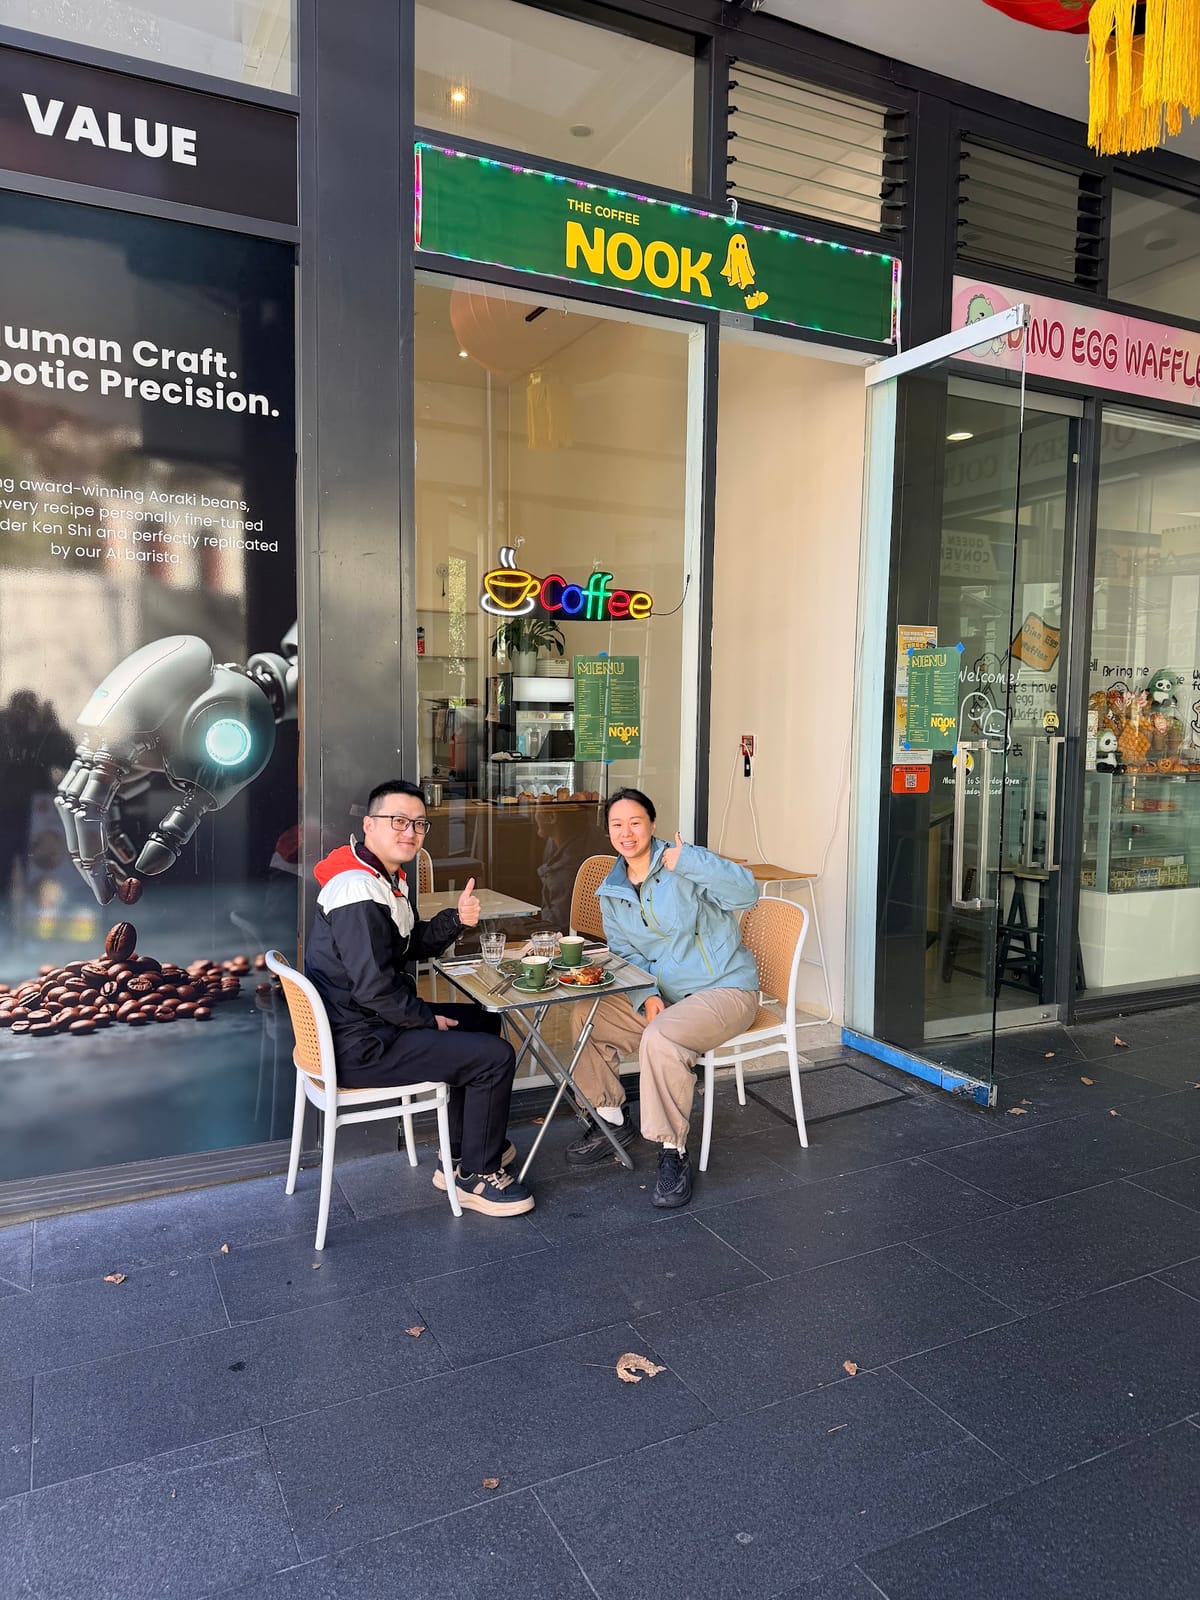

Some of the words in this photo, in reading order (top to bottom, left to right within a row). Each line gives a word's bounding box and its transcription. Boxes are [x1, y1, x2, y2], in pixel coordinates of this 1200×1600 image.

[22, 93, 197, 166] VALUE
[567, 198, 591, 215] THE
[594, 203, 640, 226] COFFEE
[566, 221, 712, 297] NOOK
[132, 340, 238, 380] Craft.
[1072, 326, 1118, 370] EGG
[100, 368, 280, 417] Precision.
[20, 480, 144, 504] award-winning
[149, 489, 197, 506] Aoraki
[201, 495, 250, 513] beans,
[44, 502, 94, 519] recipe
[100, 507, 180, 526] personally
[184, 512, 263, 532] fine-tuned
[33, 520, 63, 535] Ken
[68, 522, 92, 537] Shi
[97, 526, 127, 540] and
[132, 528, 200, 548] perfectly
[204, 534, 279, 553] replicated
[51, 543, 69, 558] by
[75, 547, 102, 558] our
[106, 547, 121, 559] AI
[540, 572, 652, 620] Coffee
[577, 661, 624, 675] MENU
[911, 654, 947, 667] MENU
[1102, 666, 1133, 678] Bring
[1032, 682, 1057, 693] have
[608, 726, 639, 737] NOOK
[930, 717, 956, 728] NOOK
